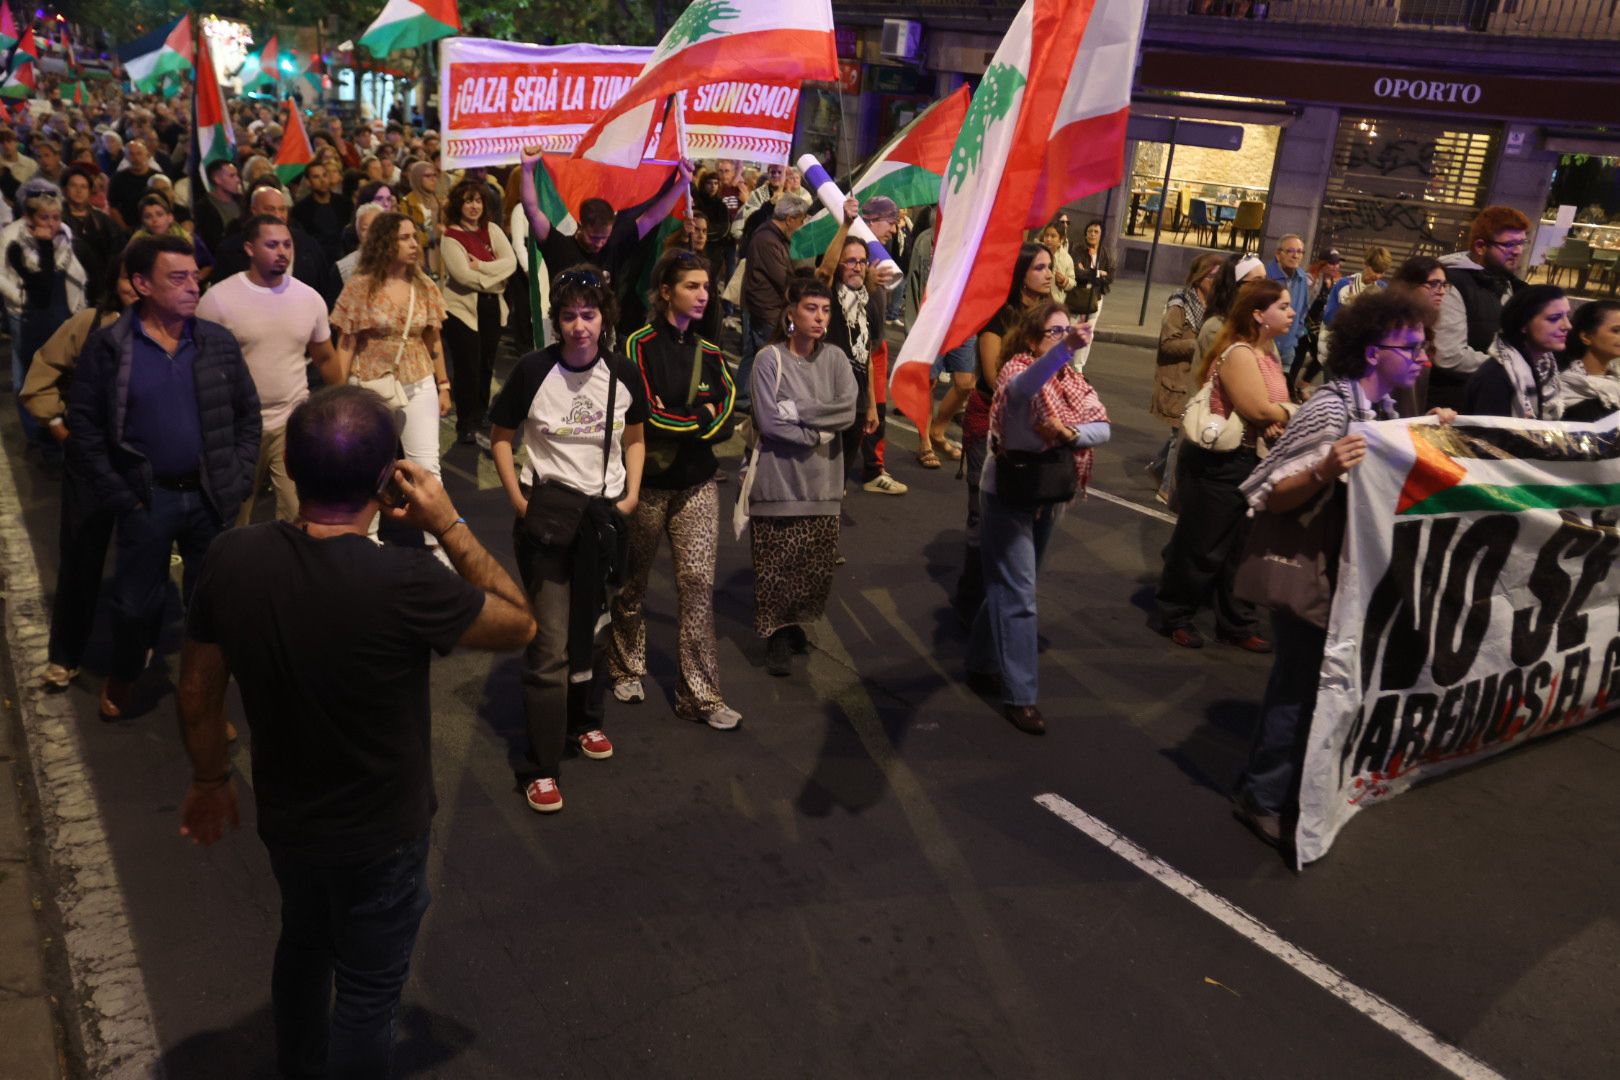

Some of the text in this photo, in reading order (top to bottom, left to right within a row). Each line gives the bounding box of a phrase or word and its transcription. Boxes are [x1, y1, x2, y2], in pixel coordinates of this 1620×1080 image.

[453, 76, 509, 121] ¡GAZA
[511, 69, 559, 113] SERÁ
[561, 76, 585, 111] LA
[590, 76, 640, 110] TUM
[693, 82, 799, 120] SIONISMO!
[1374, 77, 1482, 104] OPORTO
[1361, 509, 1620, 692] NO SE
[1338, 661, 1553, 790] PAREMOS
[1548, 646, 1591, 725] EL
